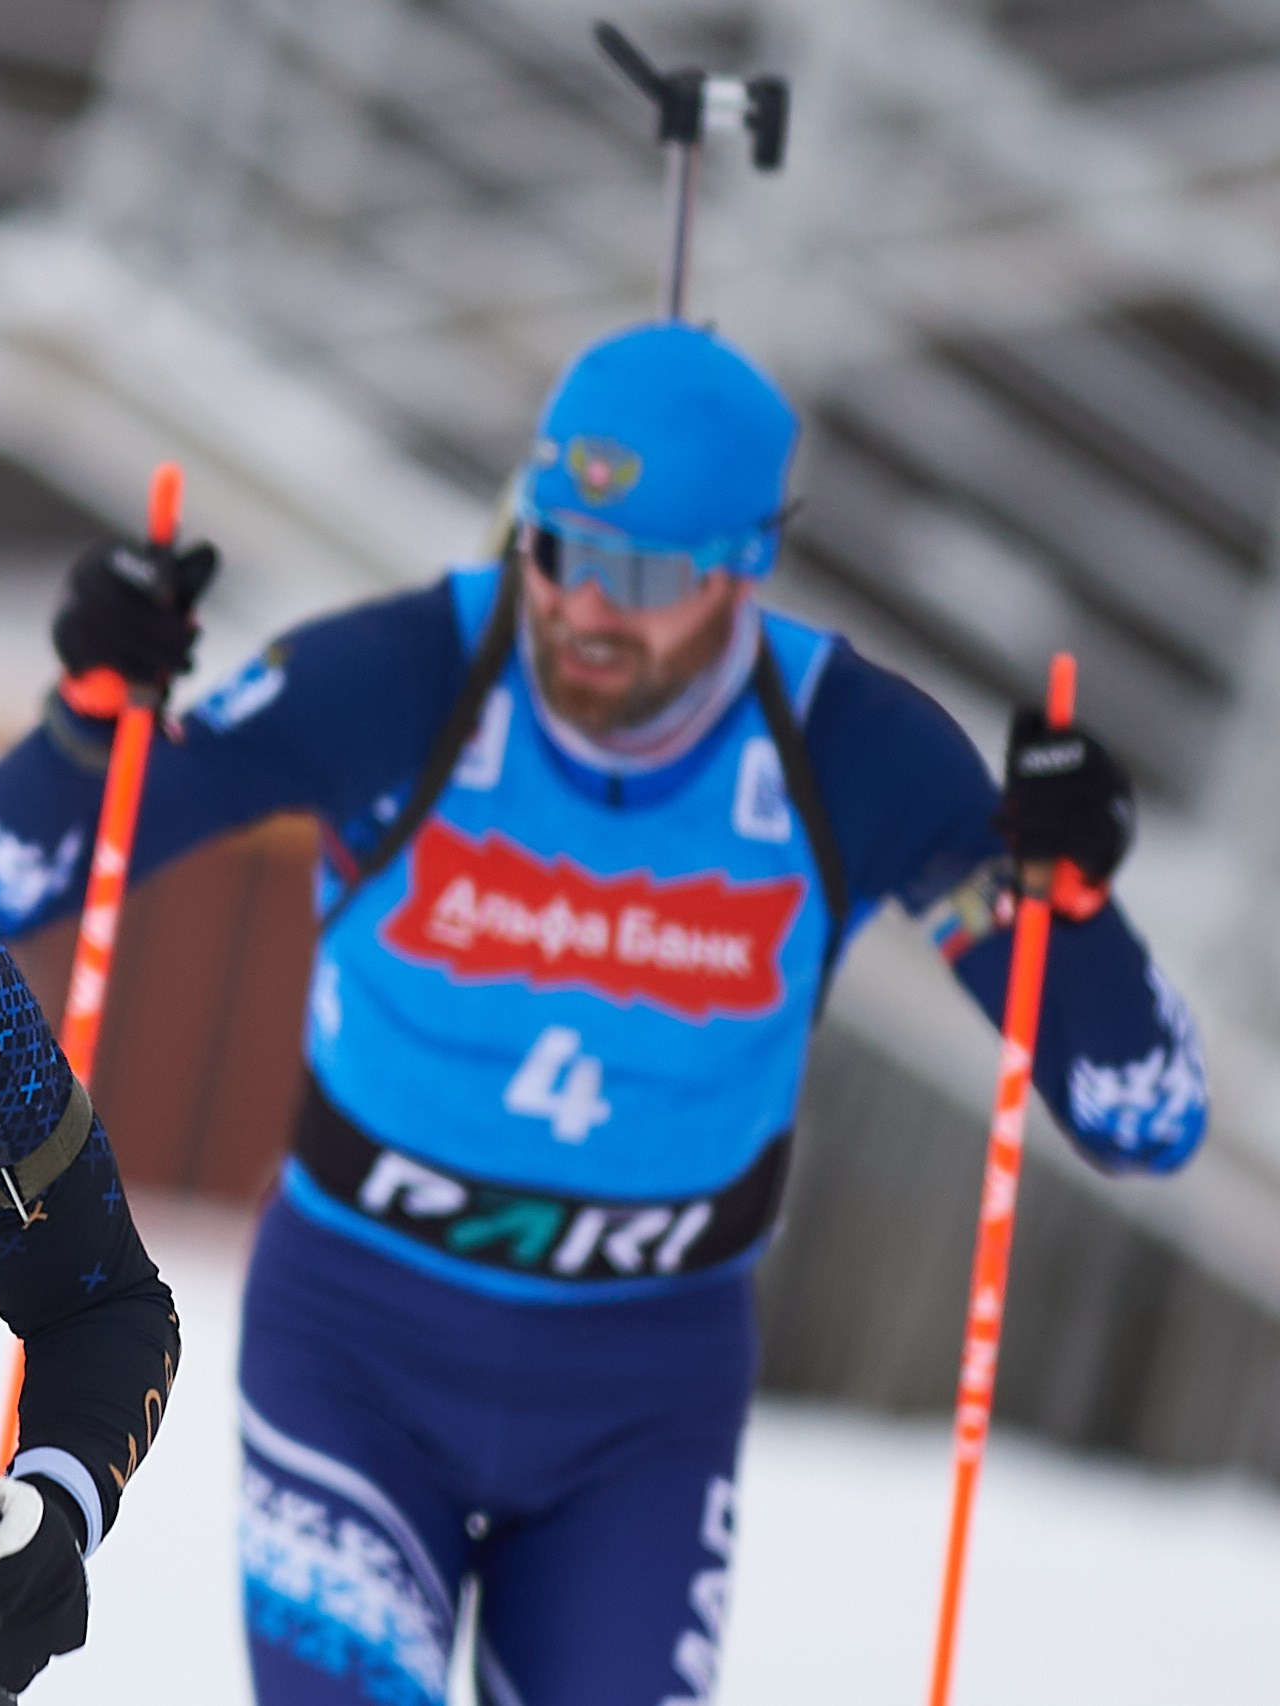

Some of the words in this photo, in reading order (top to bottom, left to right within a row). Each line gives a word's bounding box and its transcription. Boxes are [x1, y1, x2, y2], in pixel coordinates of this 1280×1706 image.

[428, 876, 609, 960] Альфа
[617, 906, 754, 979] Банк
[503, 1024, 612, 1145] 4
[358, 1148, 712, 1274] PARI
